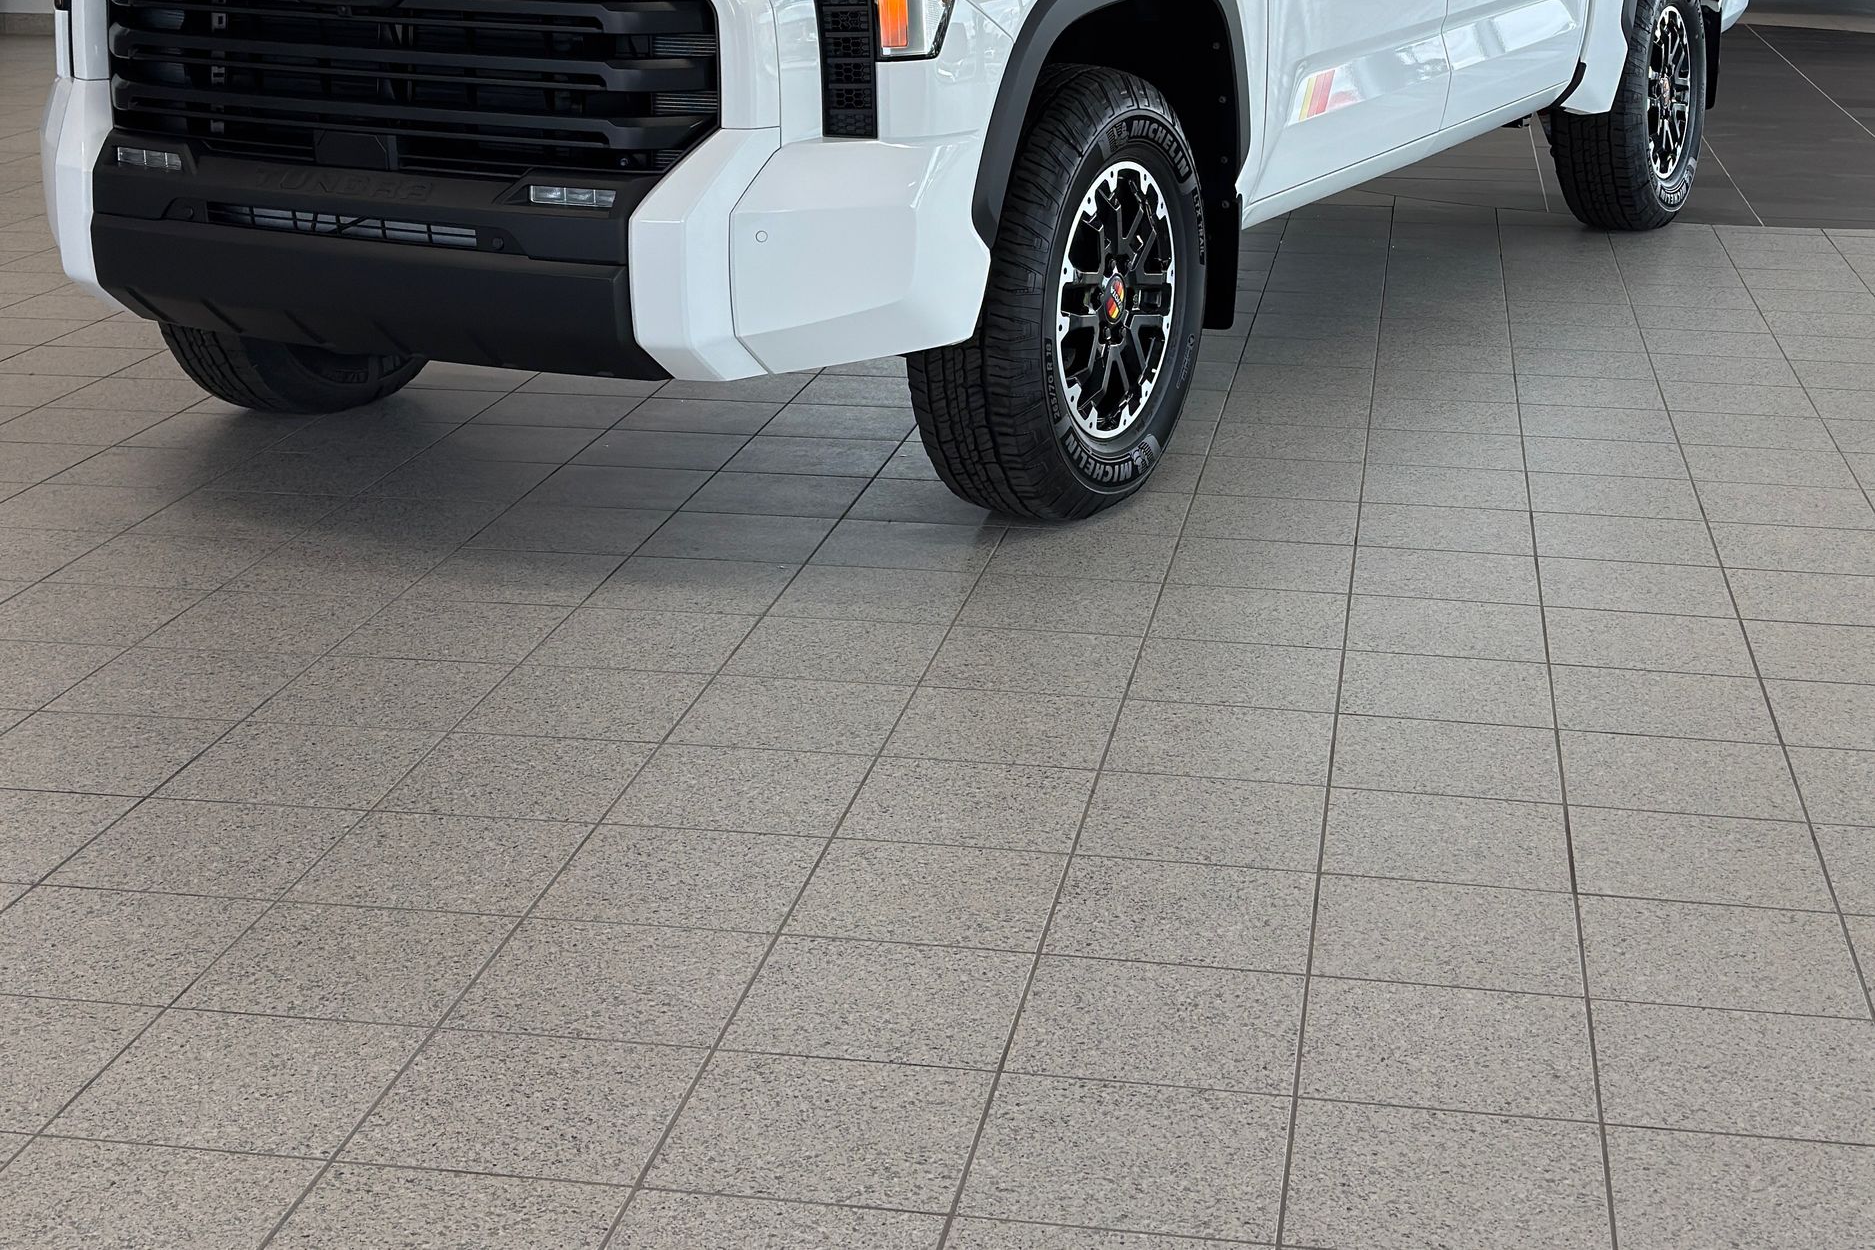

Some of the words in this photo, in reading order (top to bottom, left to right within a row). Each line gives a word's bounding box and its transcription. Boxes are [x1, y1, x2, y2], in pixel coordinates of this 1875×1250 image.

[1130, 119, 1189, 178] MICHELIN
[257, 168, 432, 201] TUNDRA
[1193, 191, 1202, 215] LTX
[1045, 343, 1052, 356] 18
[1046, 362, 1053, 371] R
[1048, 375, 1060, 420] 265/70
[1065, 437, 1132, 483] MICHELIN
